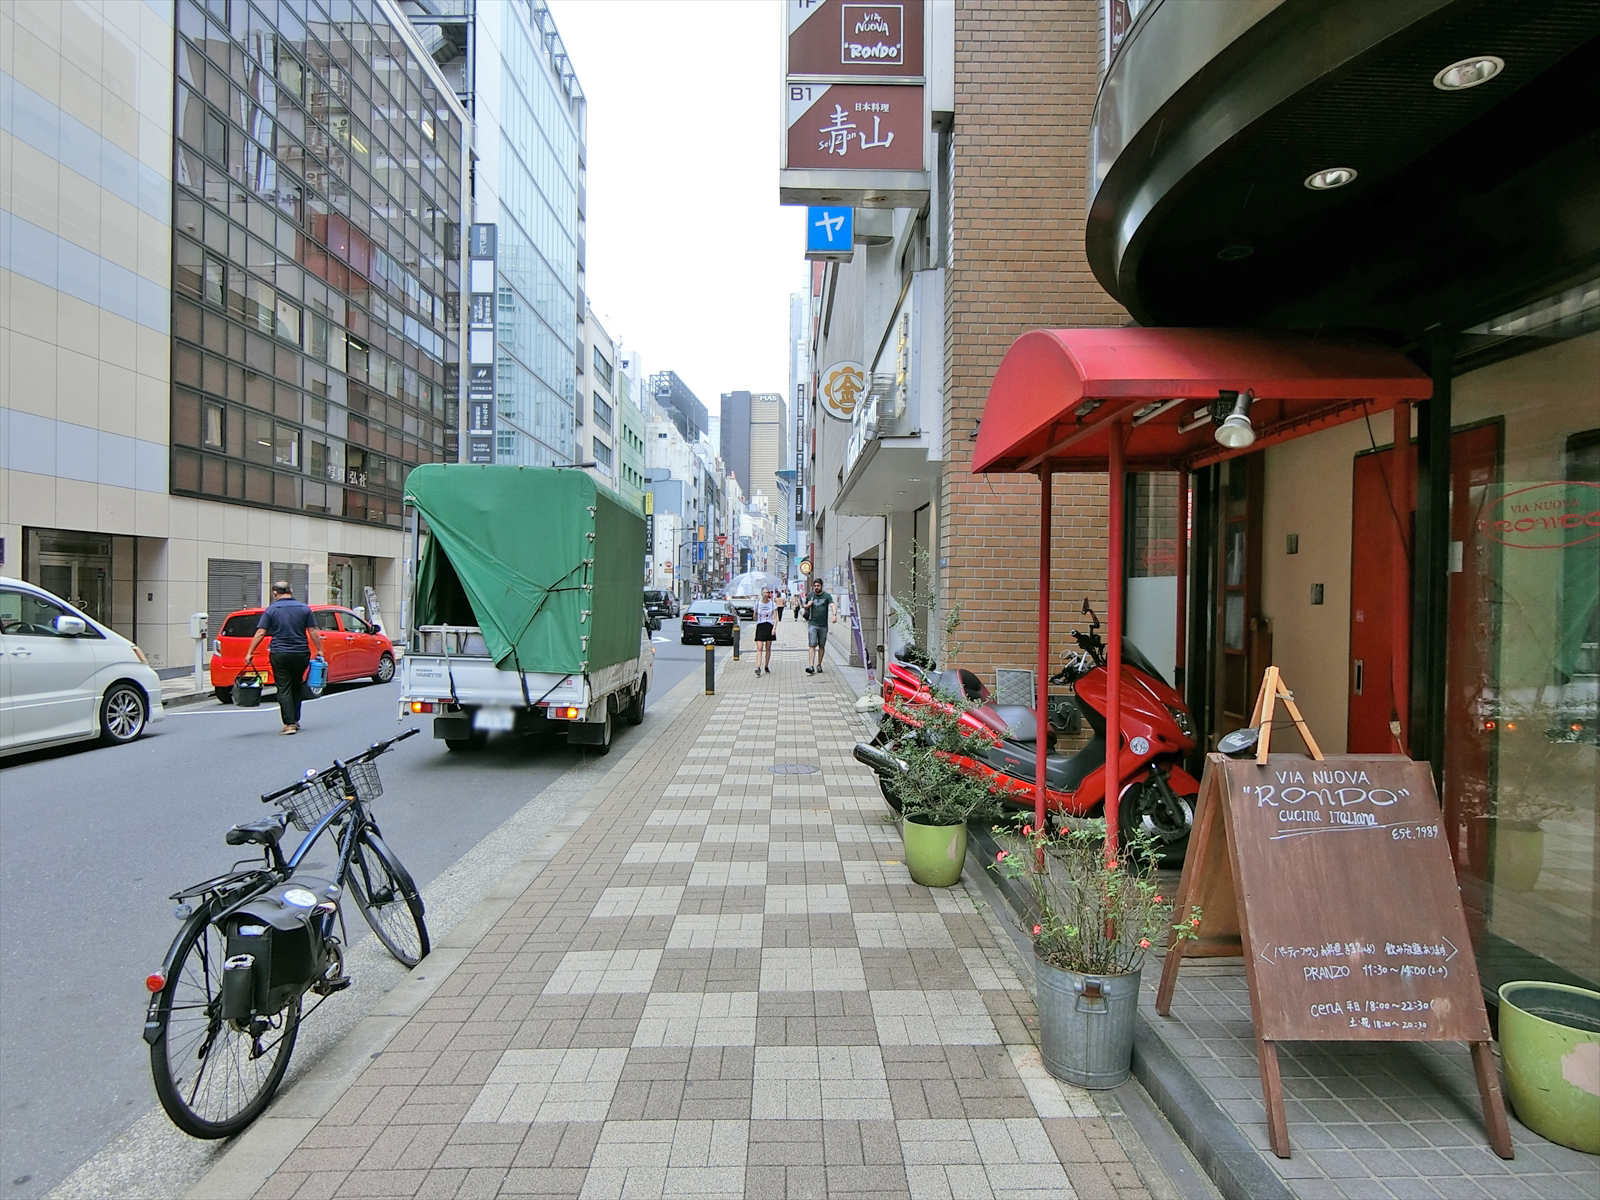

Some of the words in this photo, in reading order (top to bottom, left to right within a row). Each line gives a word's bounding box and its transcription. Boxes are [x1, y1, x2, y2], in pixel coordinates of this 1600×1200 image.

[864, 12, 882, 22] VIA
[855, 19, 889, 36] NUOVA
[790, 87, 812, 101] B1
[854, 102, 890, 113] 日本料理
[819, 104, 895, 156] 青山
[815, 211, 845, 242] ヤ
[832, 375, 864, 405] 金
[1510, 504, 1530, 513] VIA
[1276, 771, 1305, 784] VIA
[1312, 770, 1371, 785] NUOVA
[1303, 965, 1350, 981] PRANZO
